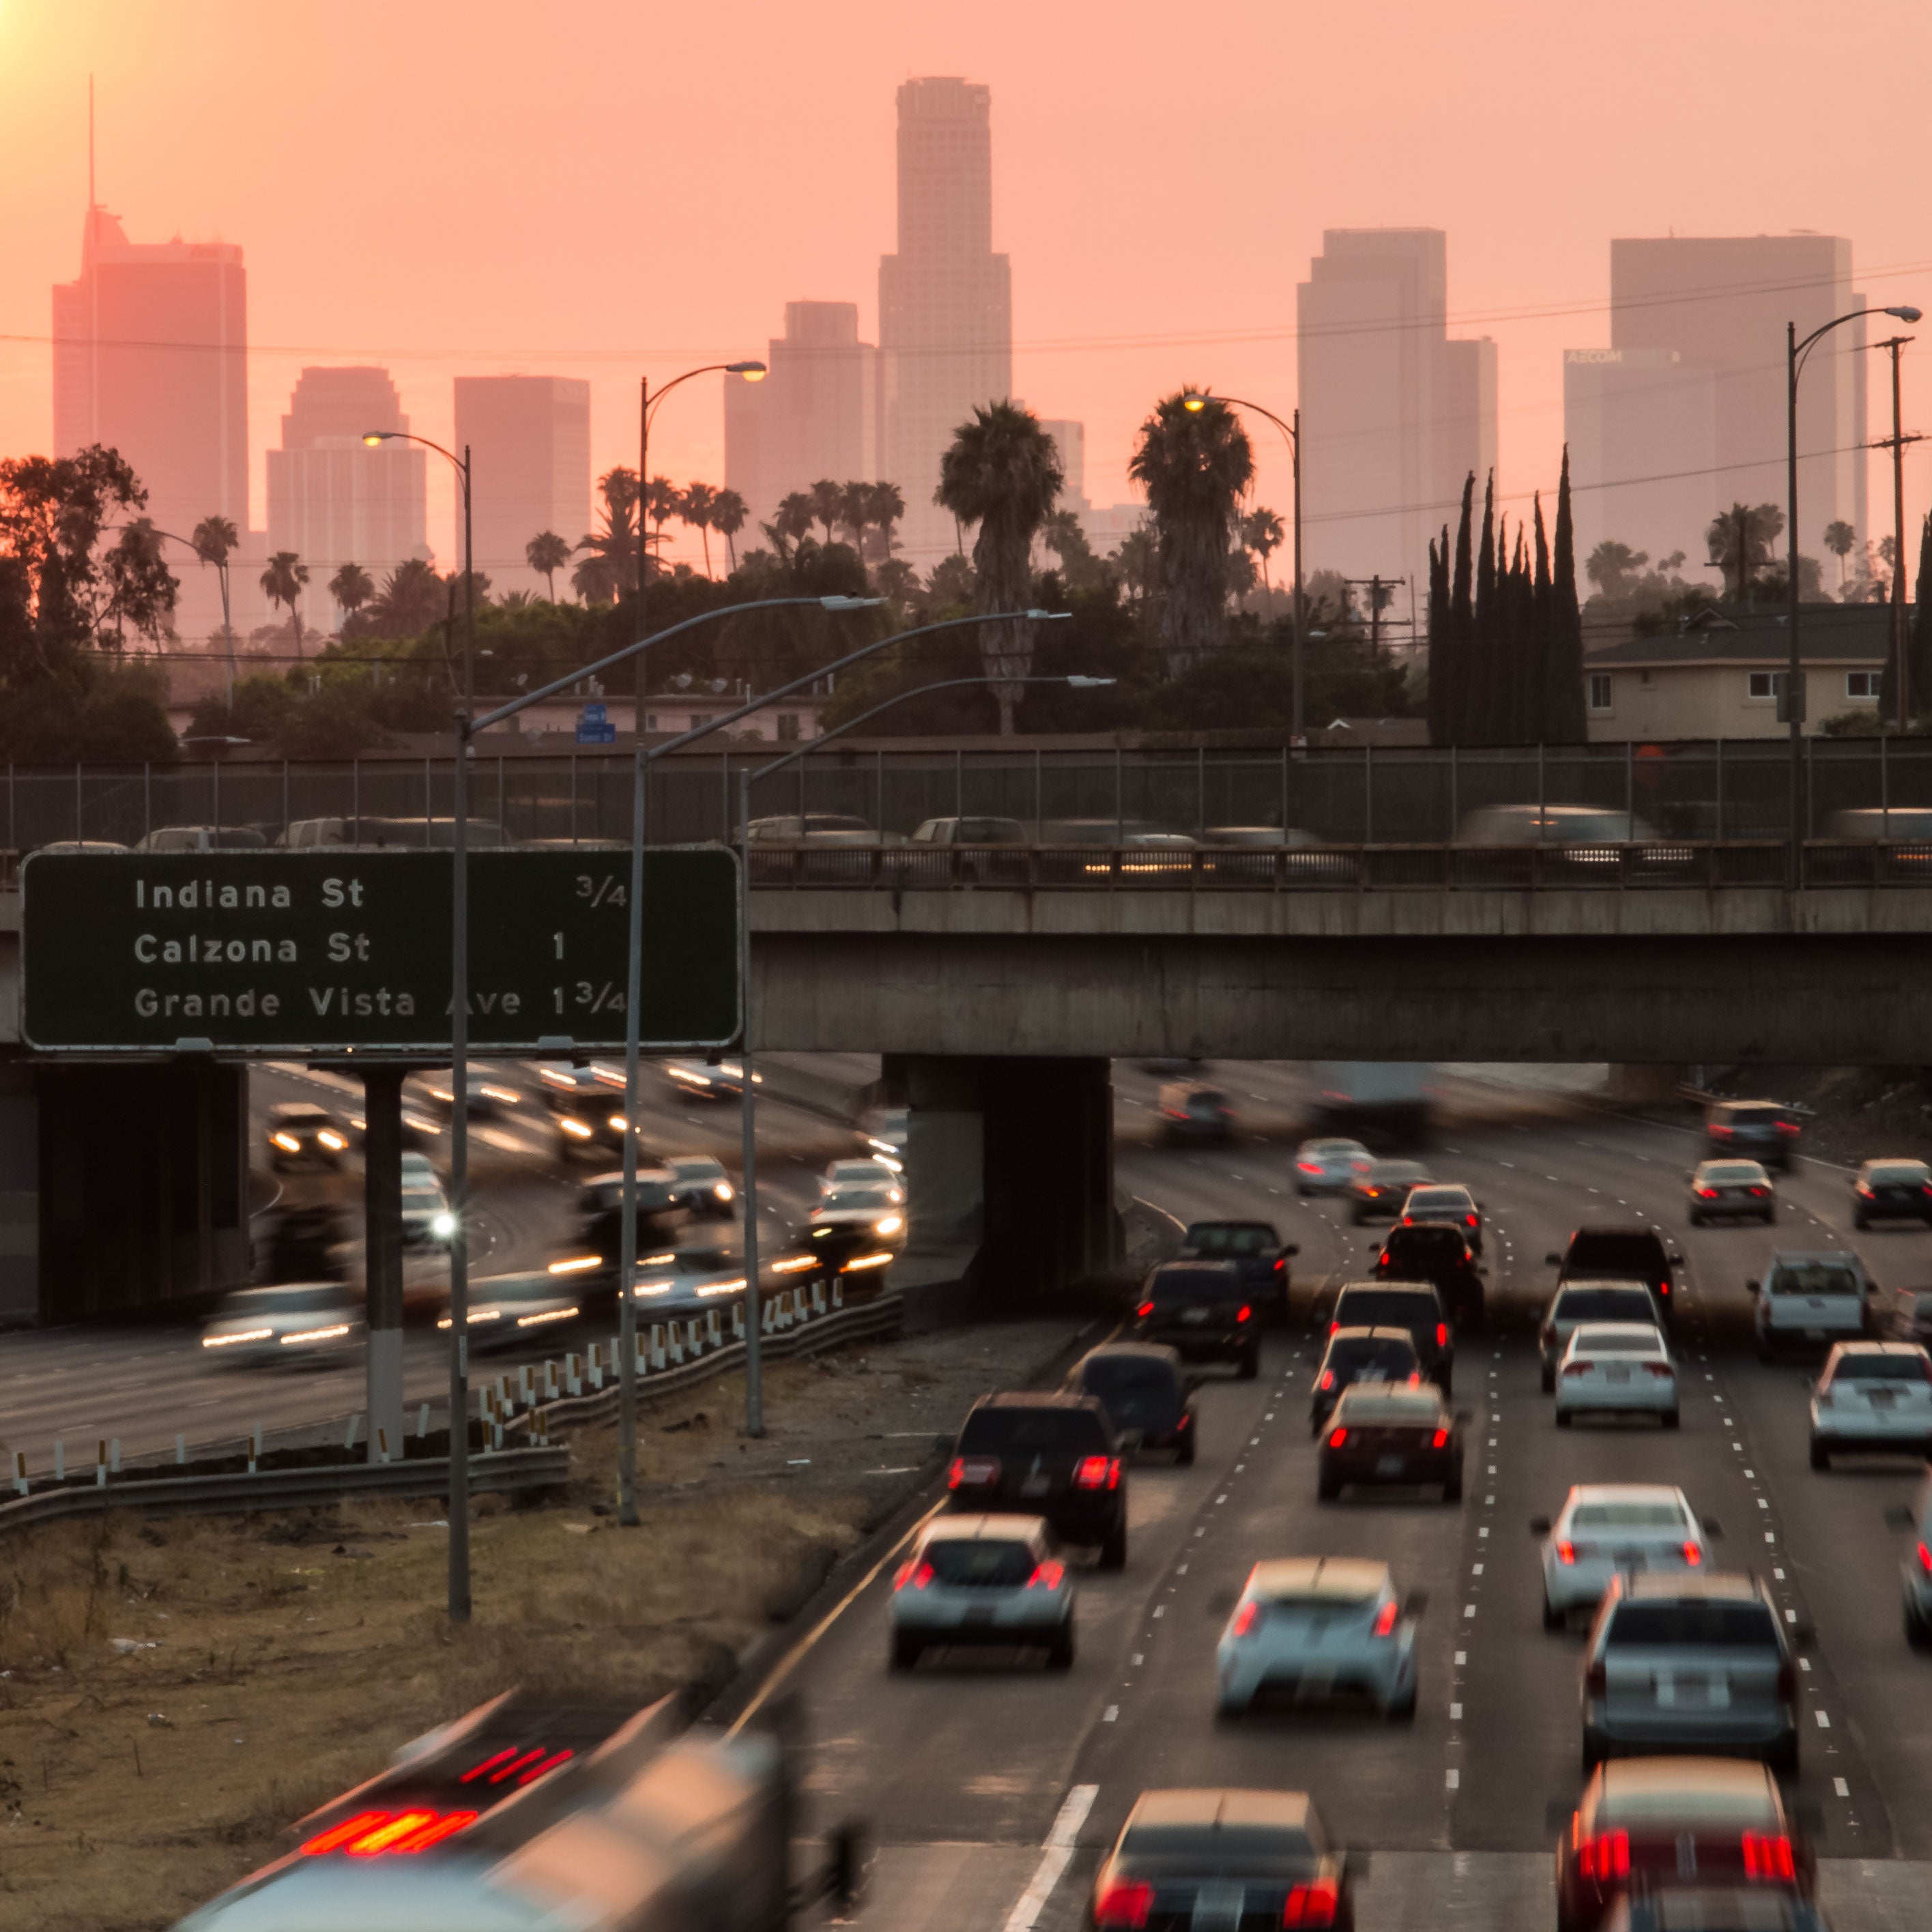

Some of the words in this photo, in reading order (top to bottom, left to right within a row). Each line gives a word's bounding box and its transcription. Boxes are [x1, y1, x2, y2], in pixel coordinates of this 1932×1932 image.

[1568, 349, 1623, 364] AECOM
[136, 879, 291, 908] Indiana
[321, 878, 364, 908] St
[134, 934, 298, 964] Calzona
[327, 932, 371, 963] St
[553, 932, 564, 960] 1
[134, 987, 280, 1018] Grande
[308, 987, 416, 1017] Vista
